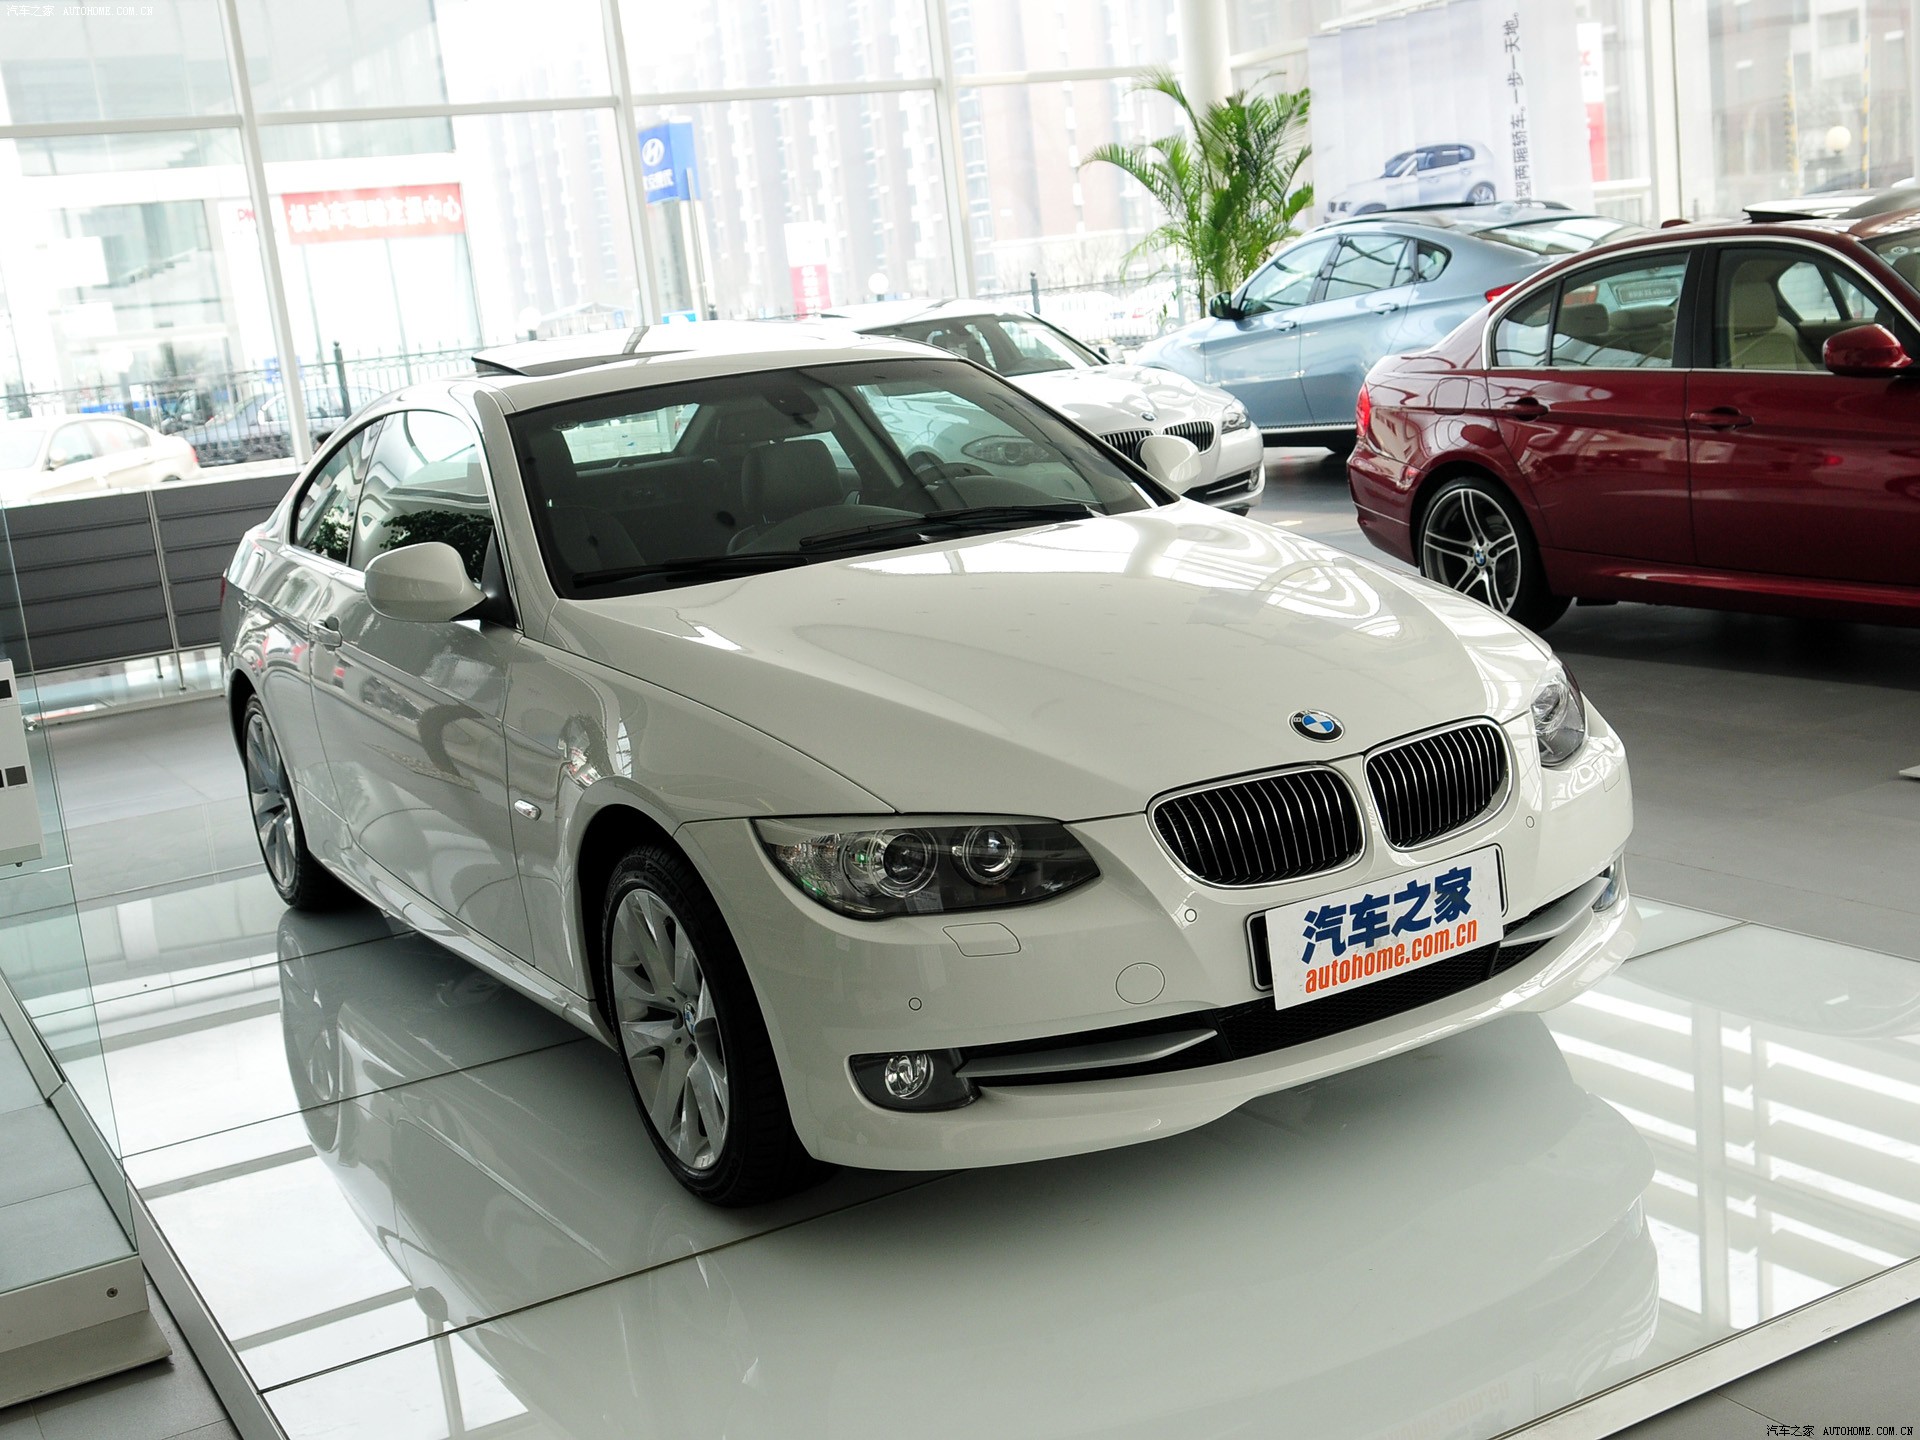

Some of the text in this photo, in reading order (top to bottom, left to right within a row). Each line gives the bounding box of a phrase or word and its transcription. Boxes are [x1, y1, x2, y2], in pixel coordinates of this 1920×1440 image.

[1301, 866, 1472, 964] 汽车之家
[1305, 918, 1478, 994] autohome.com.cn
